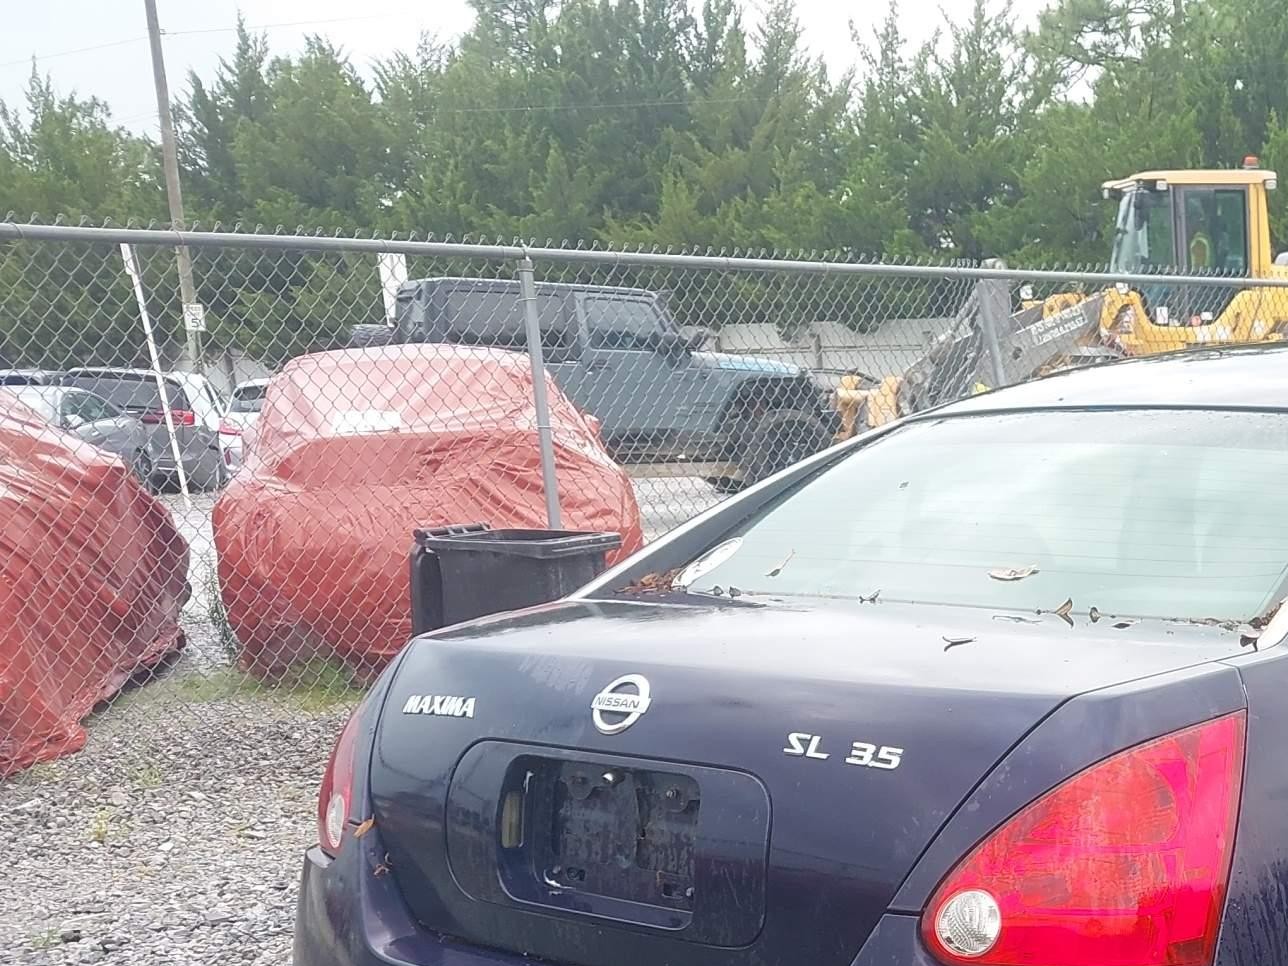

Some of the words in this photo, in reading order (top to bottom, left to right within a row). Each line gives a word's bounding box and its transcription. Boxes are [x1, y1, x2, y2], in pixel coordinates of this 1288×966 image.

[402, 694, 476, 718] MAXIMA
[595, 696, 641, 709] NISSAN
[783, 732, 831, 760] SL
